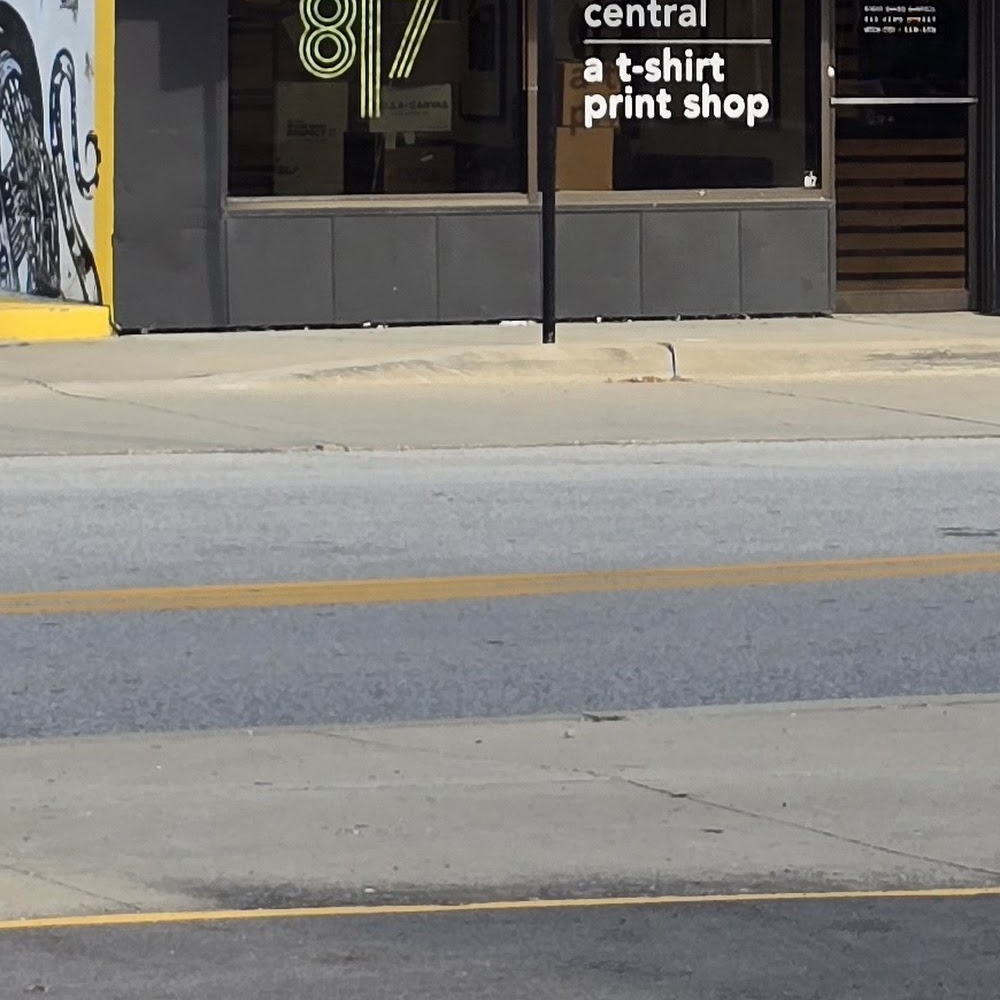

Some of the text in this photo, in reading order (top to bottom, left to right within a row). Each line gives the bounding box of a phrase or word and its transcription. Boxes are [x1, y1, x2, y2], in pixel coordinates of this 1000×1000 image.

[583, 47, 725, 82] a t-shirt
[584, 83, 770, 128] print shop
